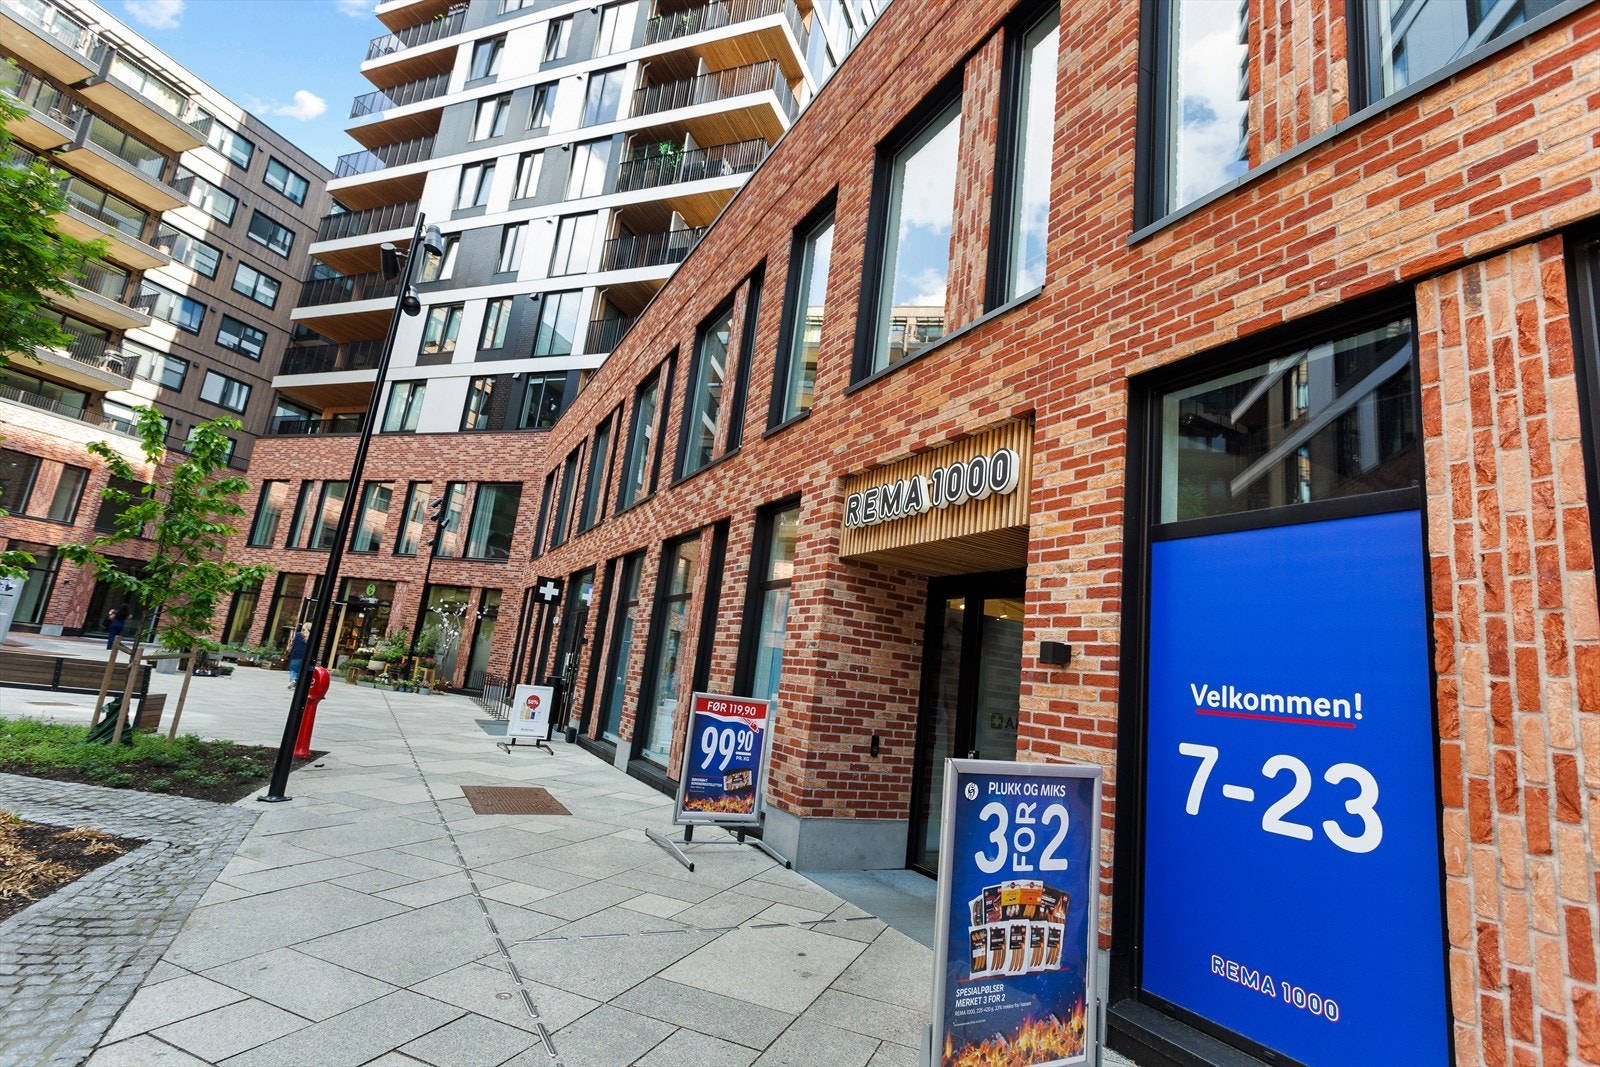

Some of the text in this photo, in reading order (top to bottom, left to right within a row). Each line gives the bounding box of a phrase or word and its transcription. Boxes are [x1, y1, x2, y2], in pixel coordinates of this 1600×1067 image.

[845, 448, 1020, 529] REMA 1000
[707, 701, 756, 716] FØR 119,90
[1190, 683, 1363, 720] Velkommen!
[701, 726, 754, 771] 99 90
[988, 782, 1066, 797] PLUKK OG MIKS
[1179, 742, 1383, 854] 7-23
[974, 802, 1070, 874] 3 FOR 2
[955, 993, 1006, 1008] MERKET 3 FOR 2
[956, 984, 1004, 997] SPESIALPØLSER
[1211, 954, 1340, 1022] REMA 1000
